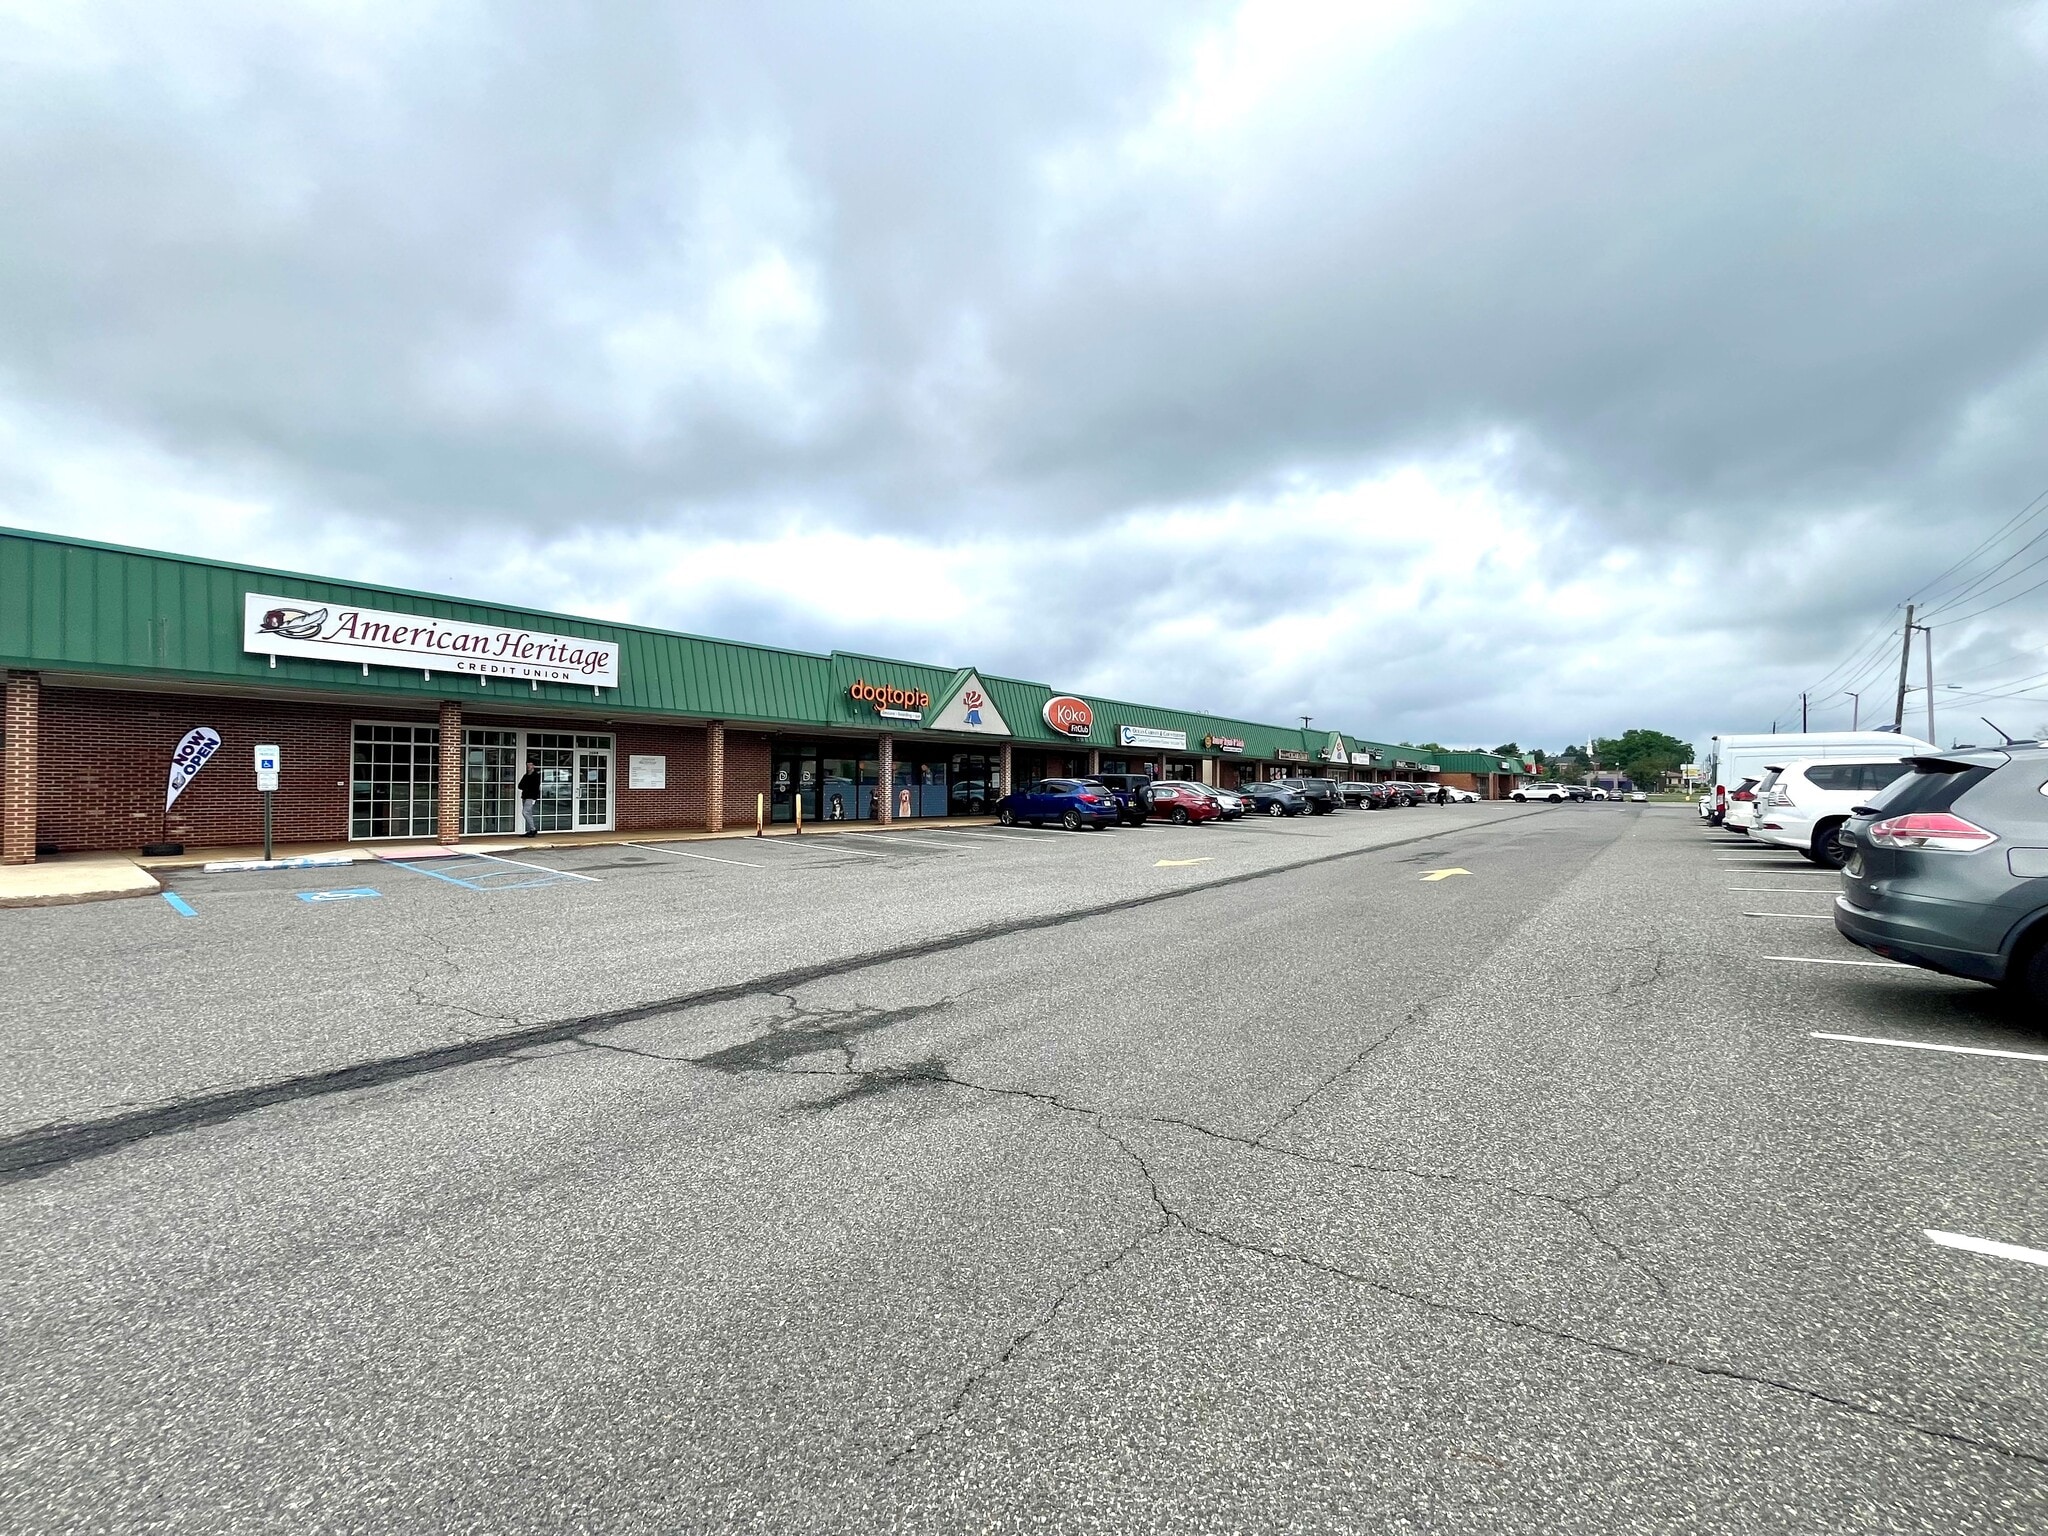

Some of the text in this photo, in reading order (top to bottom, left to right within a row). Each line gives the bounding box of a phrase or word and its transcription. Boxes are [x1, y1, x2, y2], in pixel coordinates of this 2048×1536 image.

[322, 612, 609, 675] American Heritage
[457, 661, 570, 680] CREDIT UNION
[850, 678, 929, 711] dogtopia
[173, 730, 206, 767] NOW
[183, 737, 219, 775] OPEN
